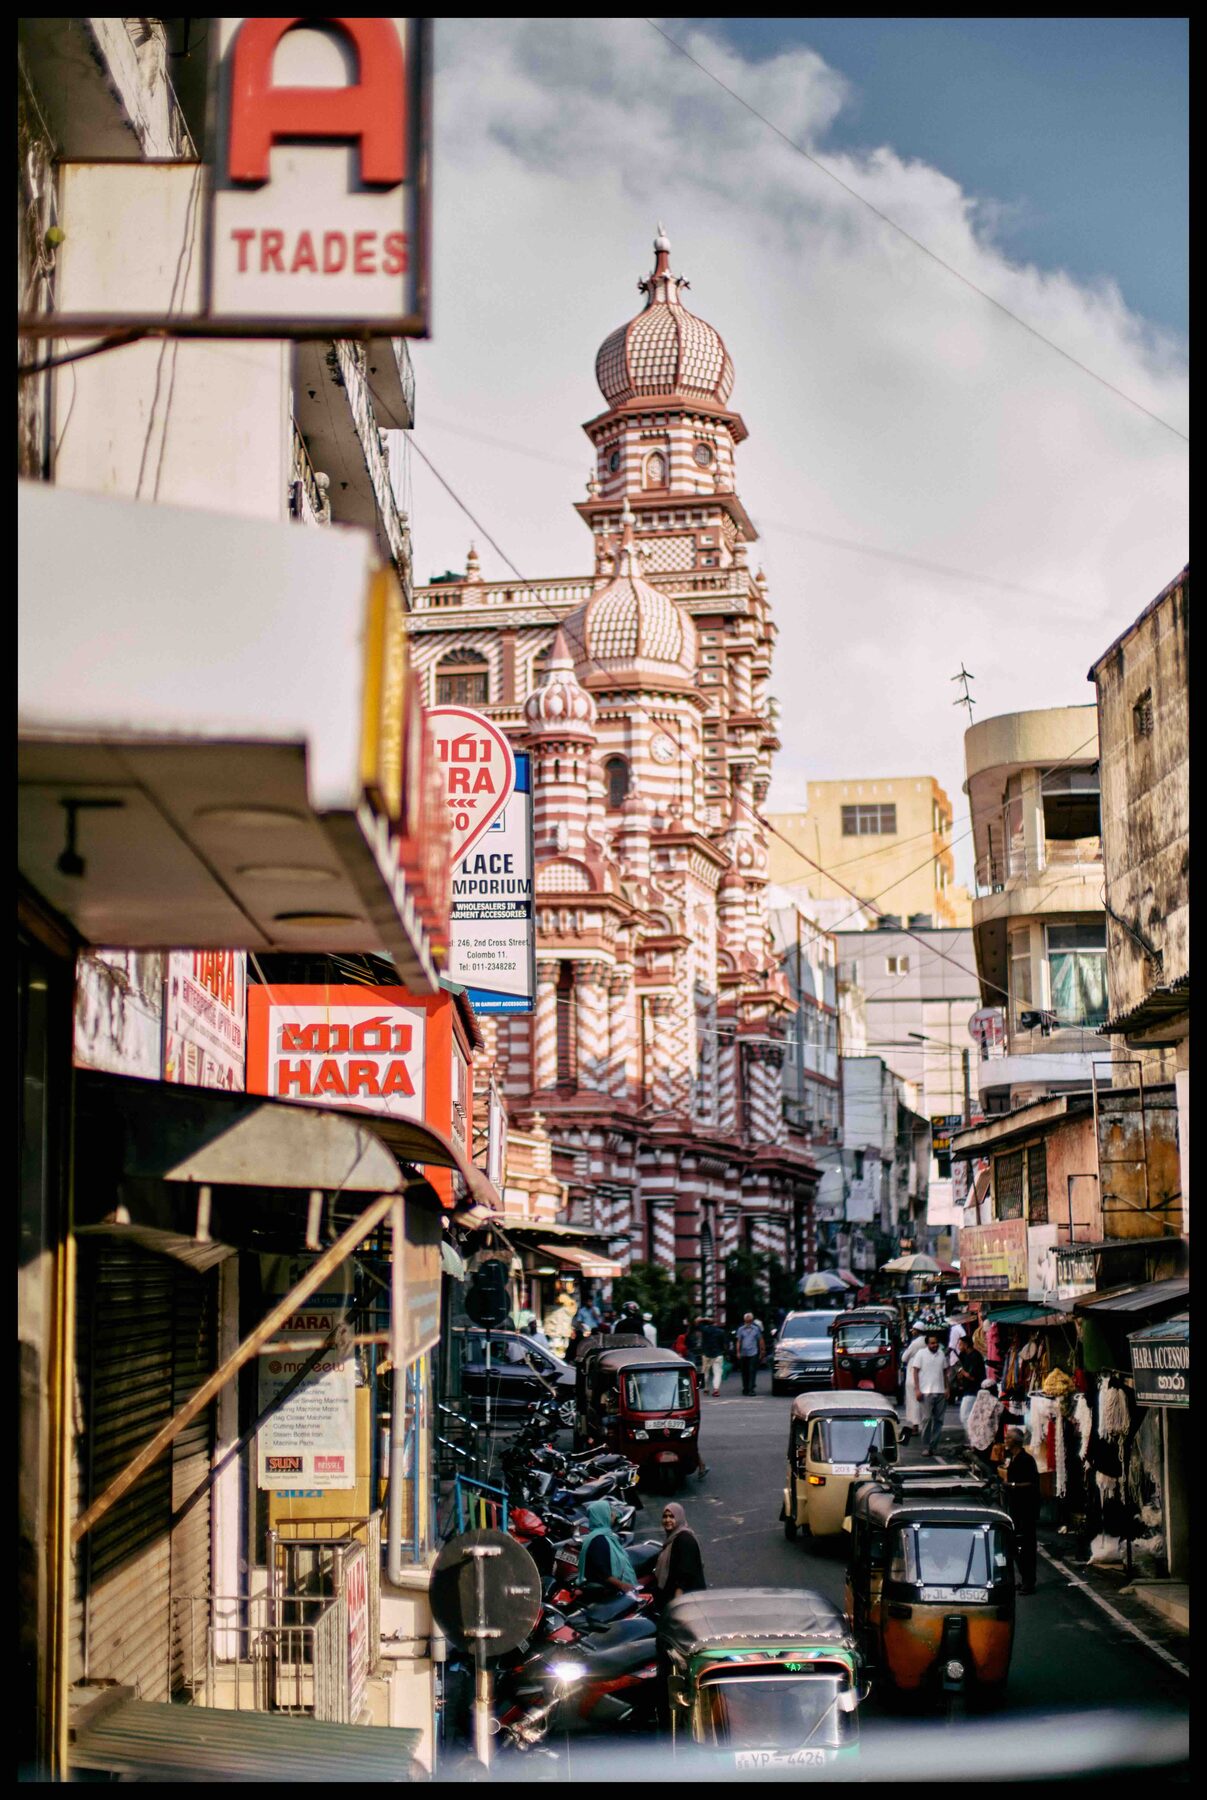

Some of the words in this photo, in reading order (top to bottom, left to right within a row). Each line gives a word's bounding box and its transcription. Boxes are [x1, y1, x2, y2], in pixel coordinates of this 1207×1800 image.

[229, 18, 406, 184] A
[231, 228, 409, 276] TRADES
[448, 767, 496, 794] RA
[462, 853, 514, 874] LACE
[452, 878, 532, 895] MPORIUM
[456, 902, 507, 911] WHOLESALERS
[507, 902, 516, 910] IN
[450, 911, 479, 919] ARMENT
[480, 910, 527, 919] ACCESSORIES
[474, 939, 487, 947] 2nd
[488, 938, 507, 947] Cross
[466, 951, 496, 959] Colombo
[459, 963, 471, 971] Tel:
[472, 962, 517, 971] 011-2348282
[276, 1059, 416, 1097] HARA
[280, 1315, 331, 1330] HARA
[1132, 1347, 1153, 1369] HARA
[269, 1458, 299, 1468] SUN
[752, 1753, 770, 1767] YP
[787, 1752, 825, 1766] 4426
